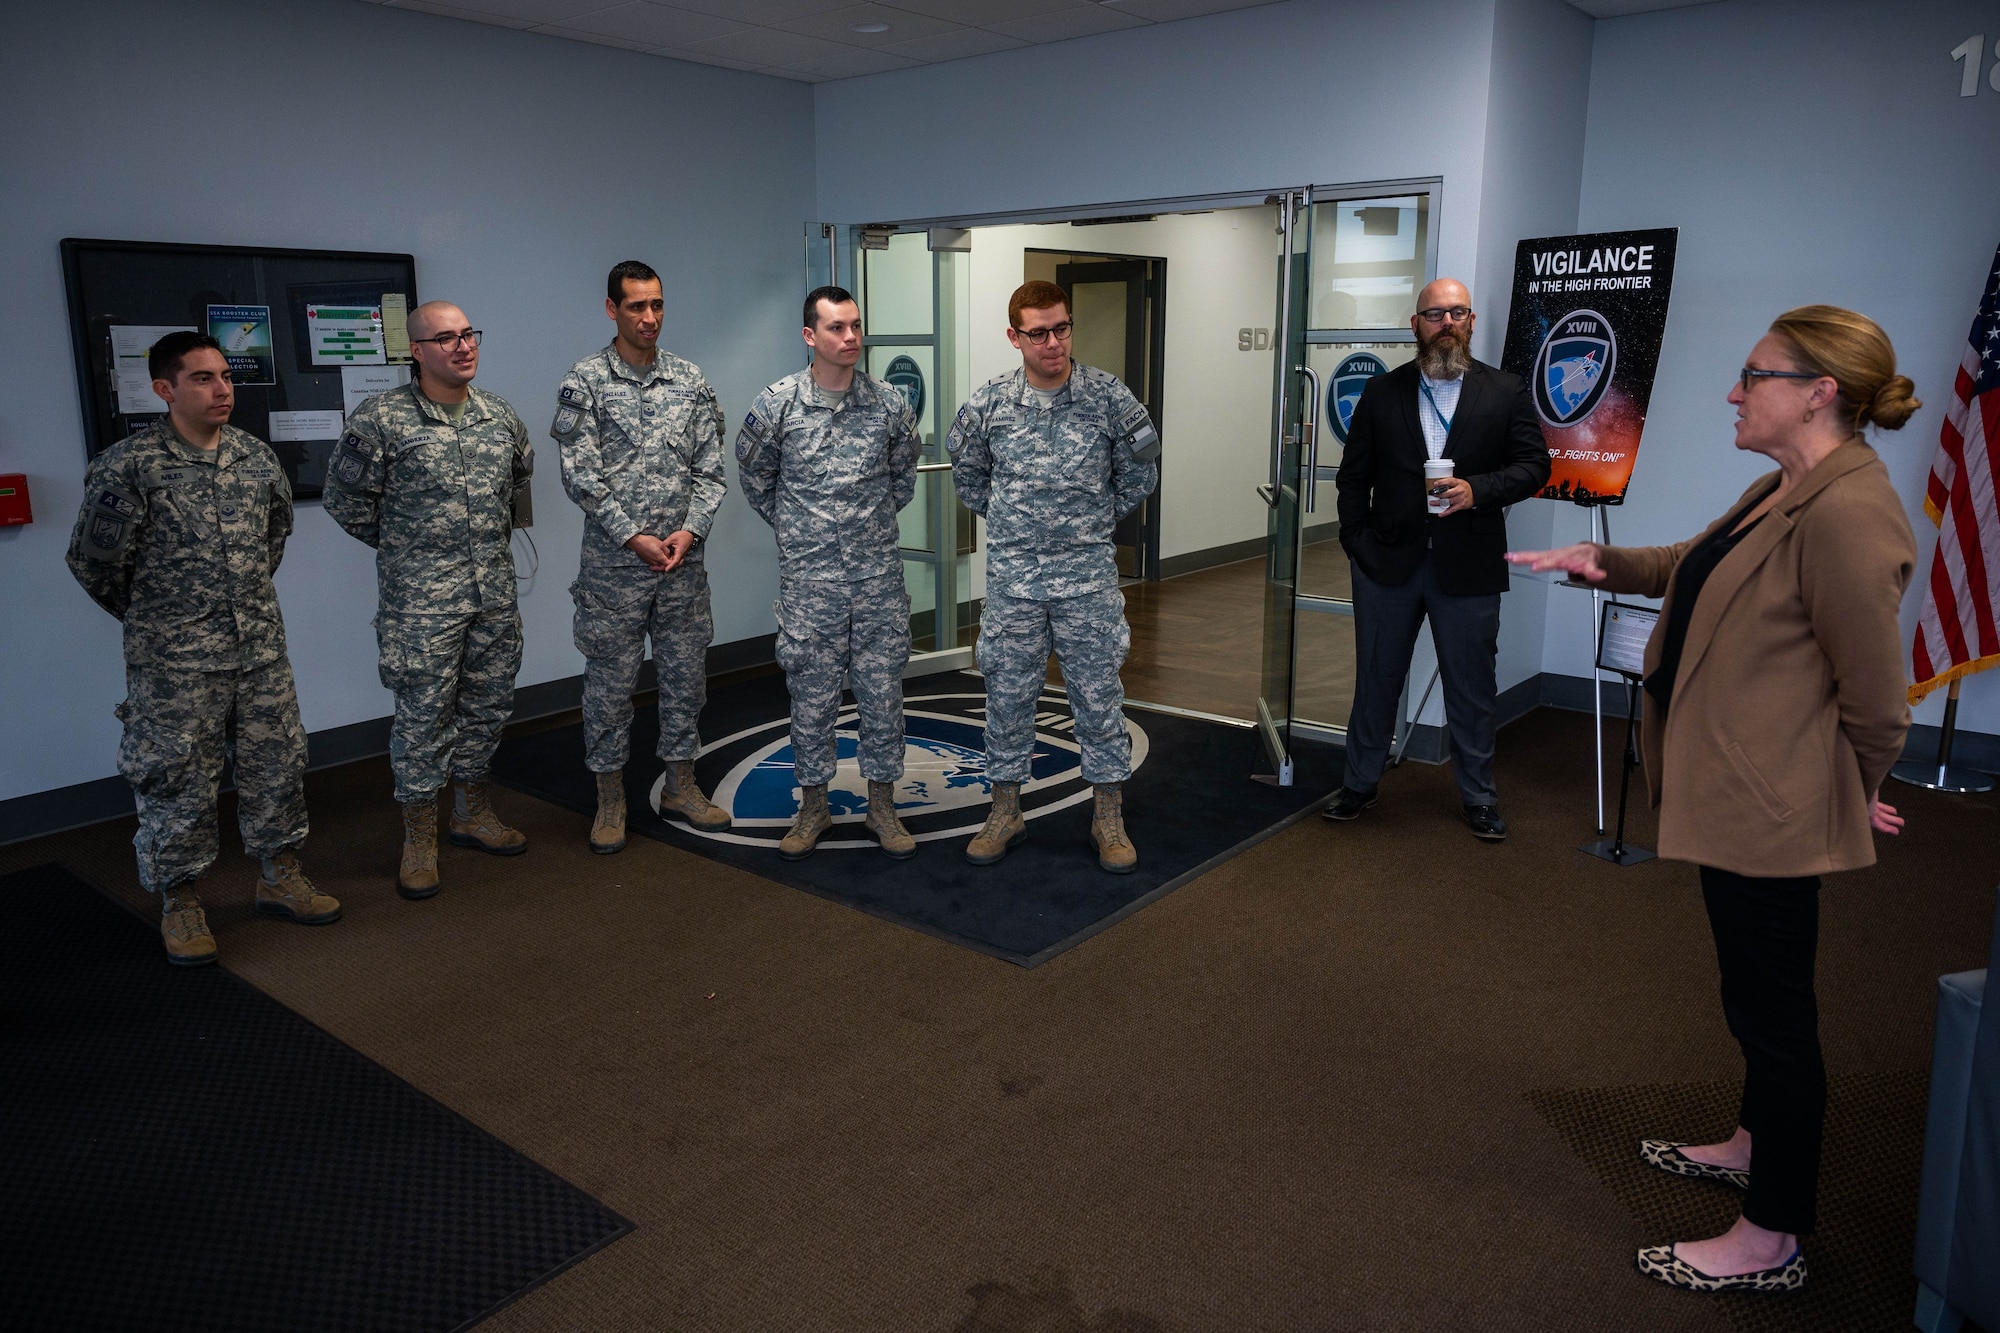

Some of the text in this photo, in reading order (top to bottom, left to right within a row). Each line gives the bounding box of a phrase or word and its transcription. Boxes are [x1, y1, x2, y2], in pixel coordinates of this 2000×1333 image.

[1532, 245, 1655, 276] VIGILANCE
[1528, 276, 1652, 293] IN THE HIGH FRONTIER
[1565, 321, 1597, 334] XVIII
[233, 335, 245, 350] VOTE
[895, 363, 912, 371] XVIII
[1348, 361, 1377, 373] XVIII
[1124, 408, 1145, 427] FACH
[400, 435, 431, 447] SANHUEZA
[161, 472, 184, 481] AVILES
